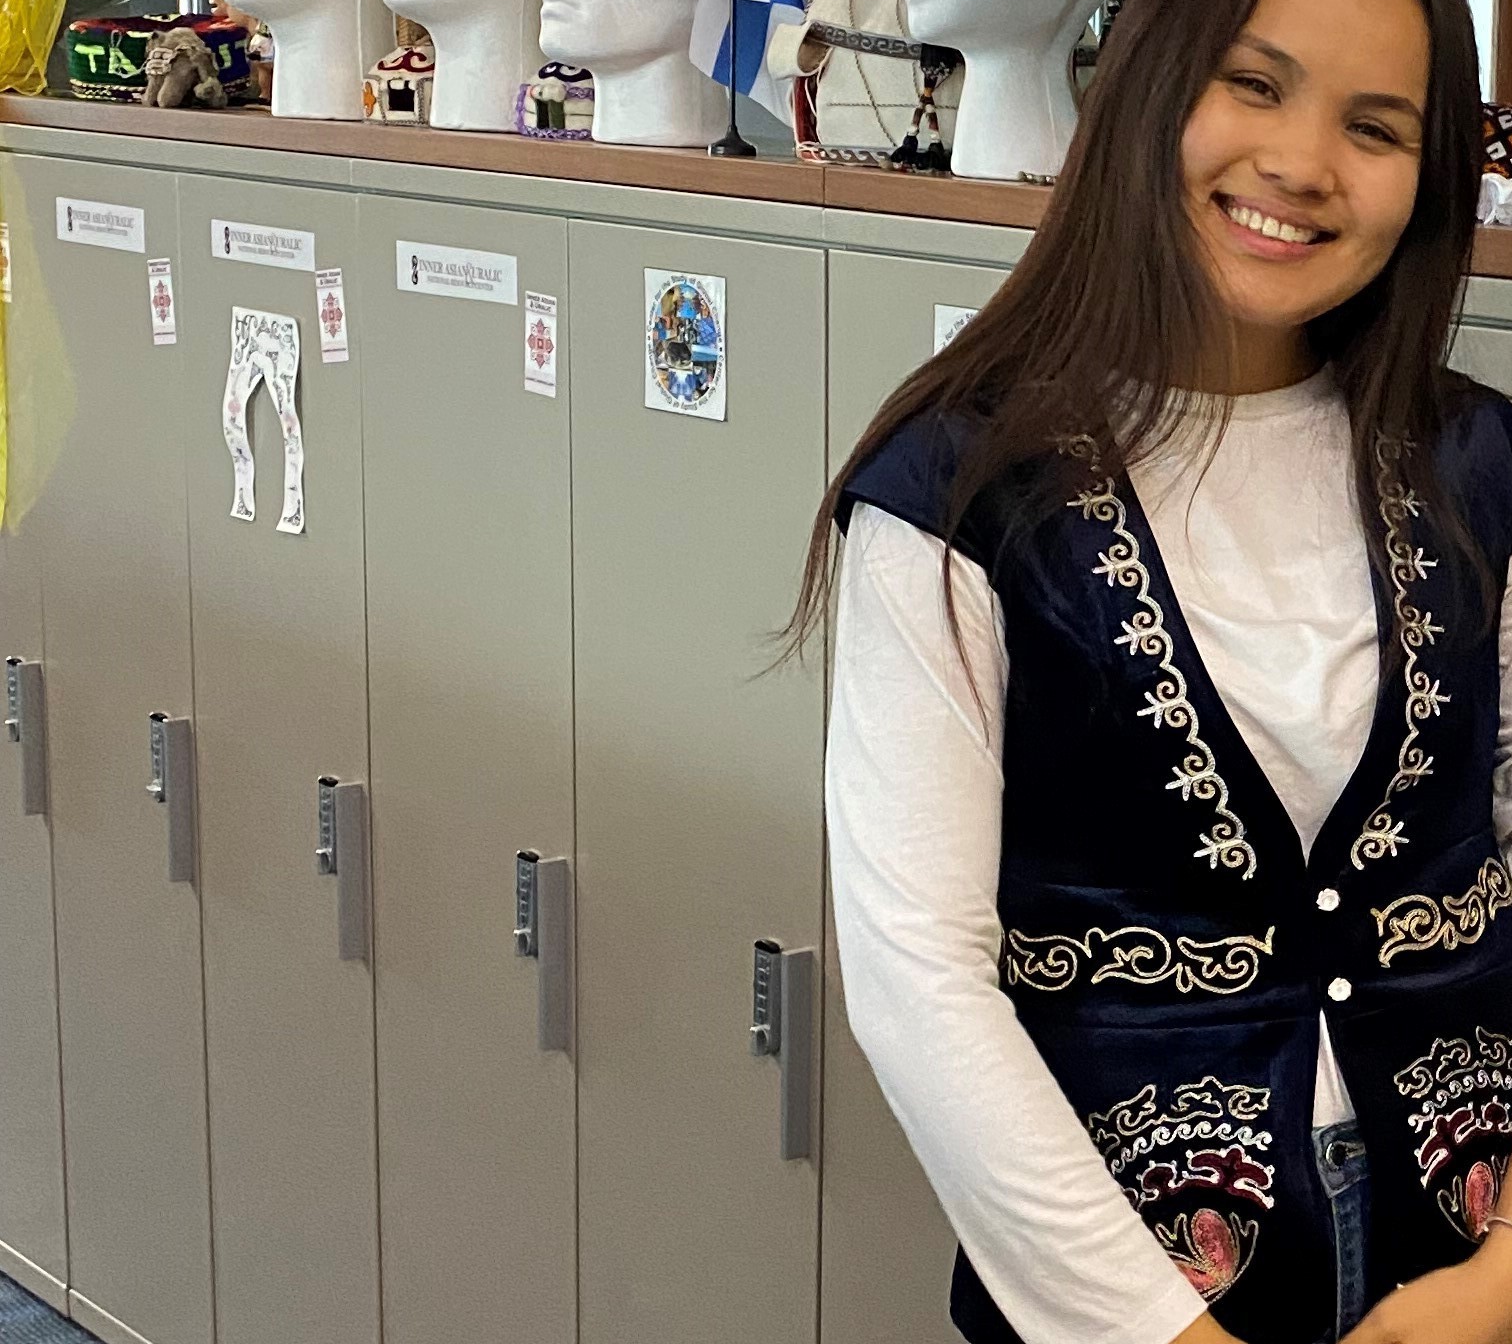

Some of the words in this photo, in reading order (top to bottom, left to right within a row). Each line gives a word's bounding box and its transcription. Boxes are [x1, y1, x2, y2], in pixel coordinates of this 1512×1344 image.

[419, 259, 443, 273] INNER
[446, 263, 466, 276] ASIAN
[472, 266, 502, 282] URALIC
